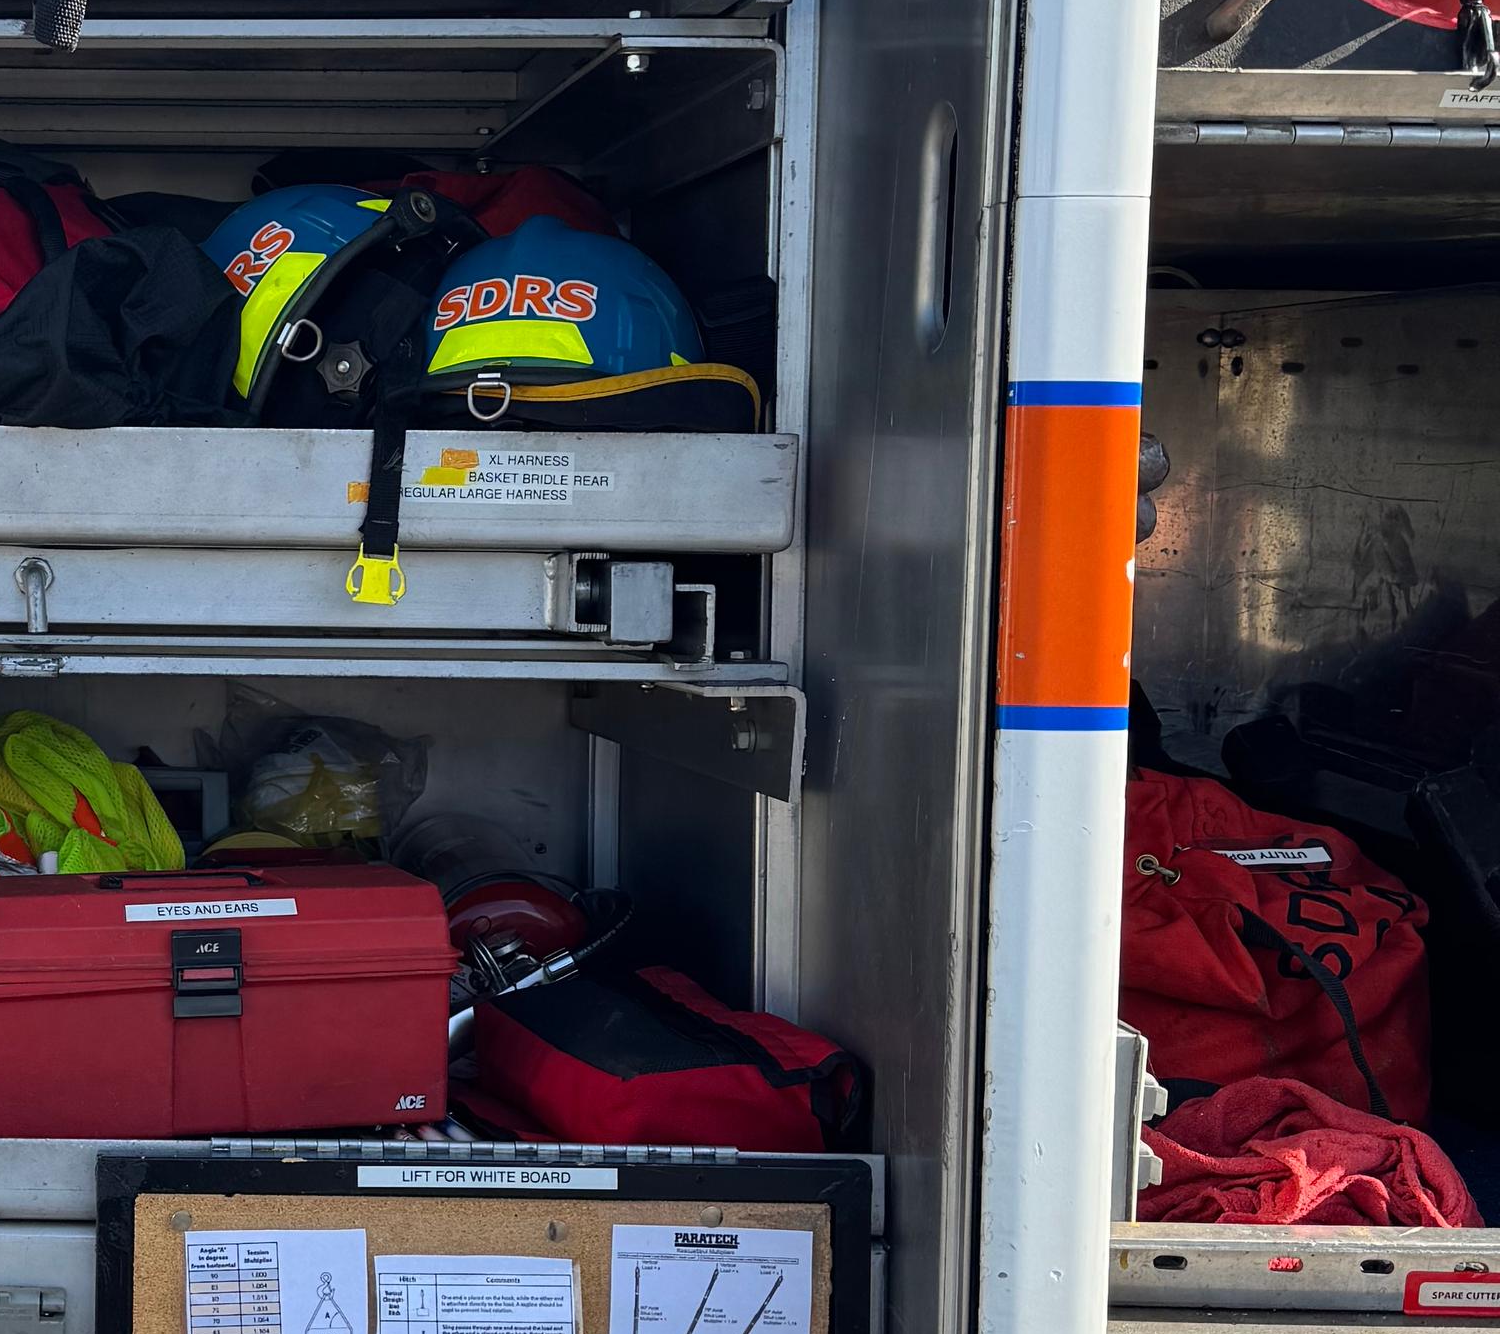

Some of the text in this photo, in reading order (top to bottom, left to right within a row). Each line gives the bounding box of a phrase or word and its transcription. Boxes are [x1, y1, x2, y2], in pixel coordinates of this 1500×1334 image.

[1451, 94, 1500, 103] TRAFF
[433, 274, 599, 332] SDRS
[489, 455, 569, 467] XL HARNESS
[469, 472, 609, 487] BASKET BRIDLE REAR
[460, 489, 502, 500] LARGE
[506, 490, 567, 500] HARNESS
[1260, 851, 1308, 860] UTILITY
[157, 903, 259, 917] EYES AND EARS
[196, 942, 220, 954] ACE
[394, 1095, 426, 1110] ACE
[402, 1171, 571, 1184] LIFT FOR WHITE BOARD
[674, 1232, 739, 1245] PARATECH
